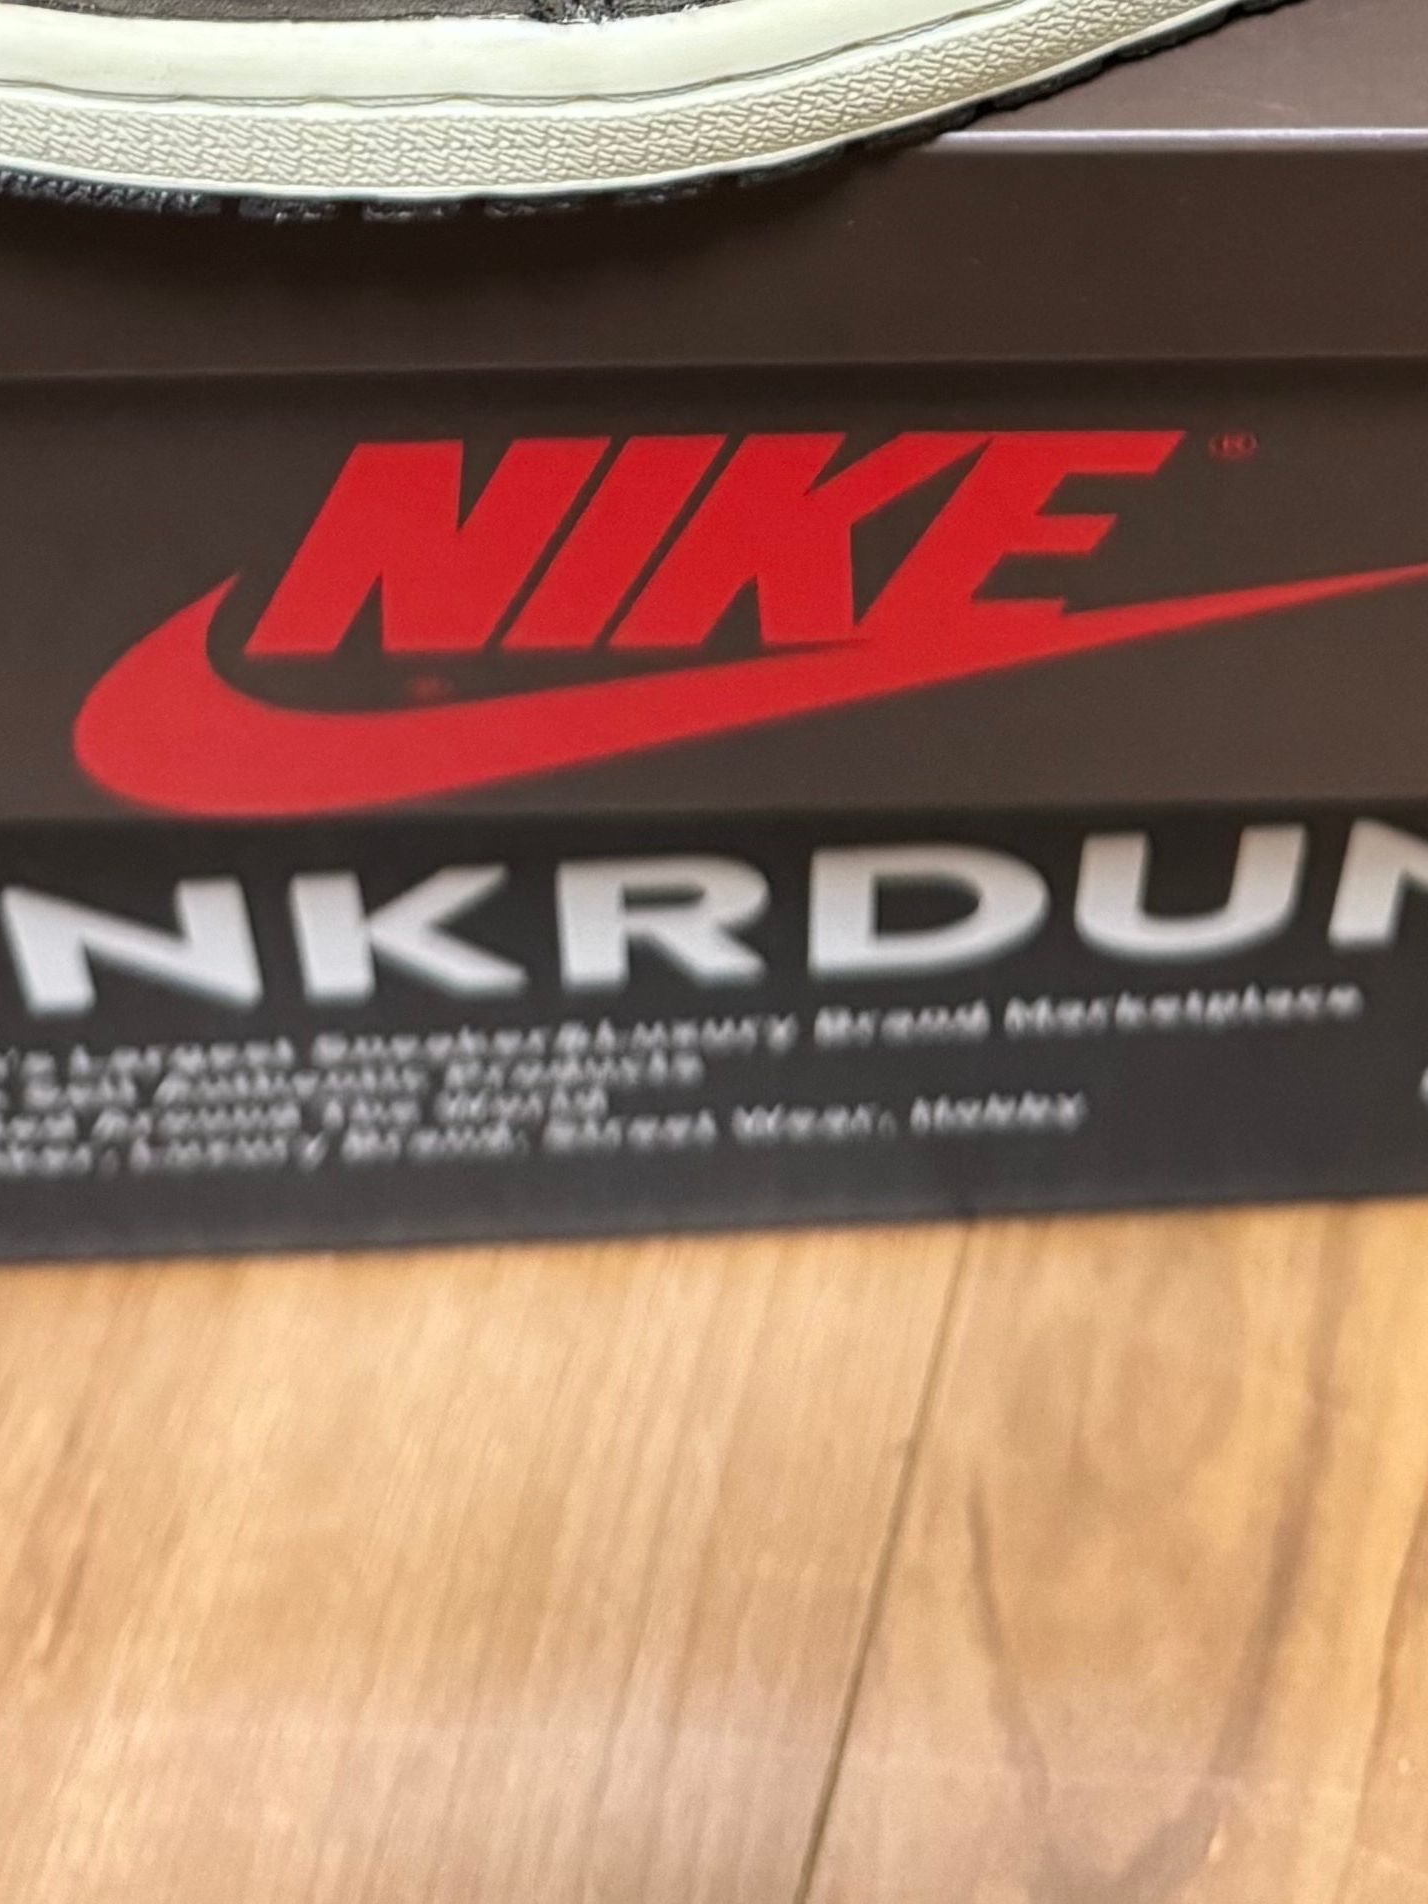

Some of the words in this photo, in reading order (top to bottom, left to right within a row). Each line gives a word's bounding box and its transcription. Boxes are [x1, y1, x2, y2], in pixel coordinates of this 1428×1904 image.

[243, 430, 1185, 656] NIKE
[71, 1037, 295, 1084] Largest
[812, 998, 993, 1048] Brand
[1003, 985, 1364, 1038] Marketplace
[909, 1092, 1087, 1136] Hobby
